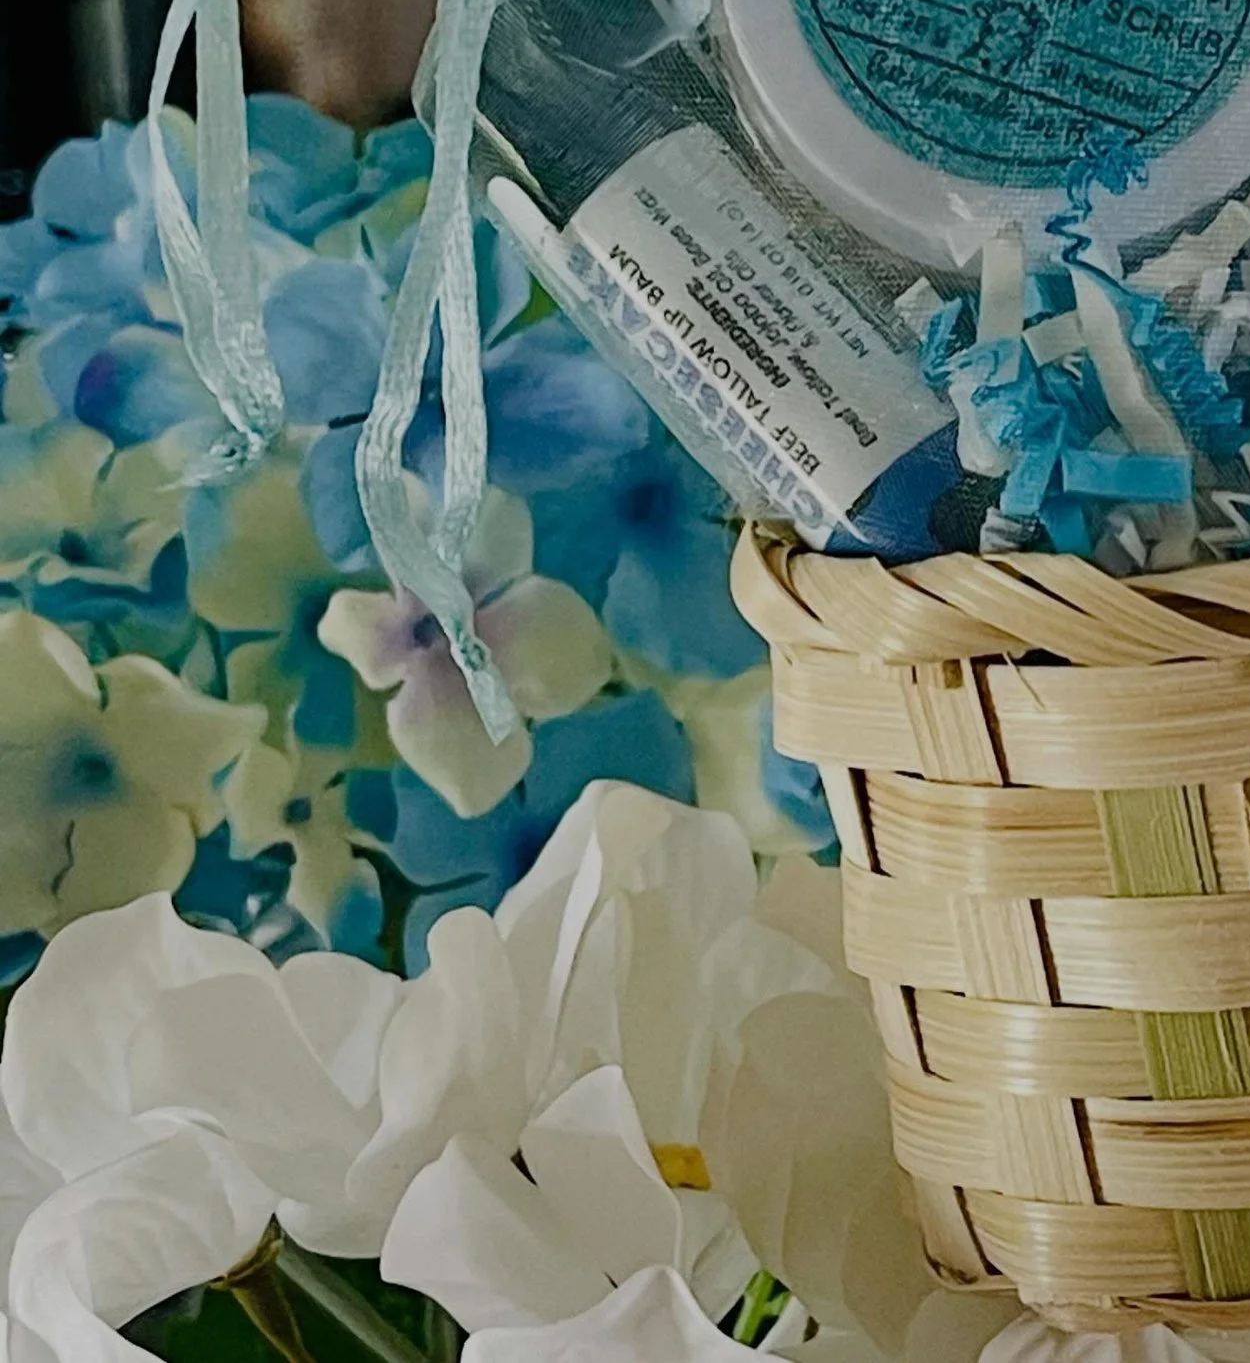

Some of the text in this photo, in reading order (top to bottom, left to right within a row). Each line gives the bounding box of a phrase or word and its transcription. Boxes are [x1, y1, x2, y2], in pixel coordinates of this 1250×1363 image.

[602, 241, 823, 477] BEEF TALLOW LIP BALM
